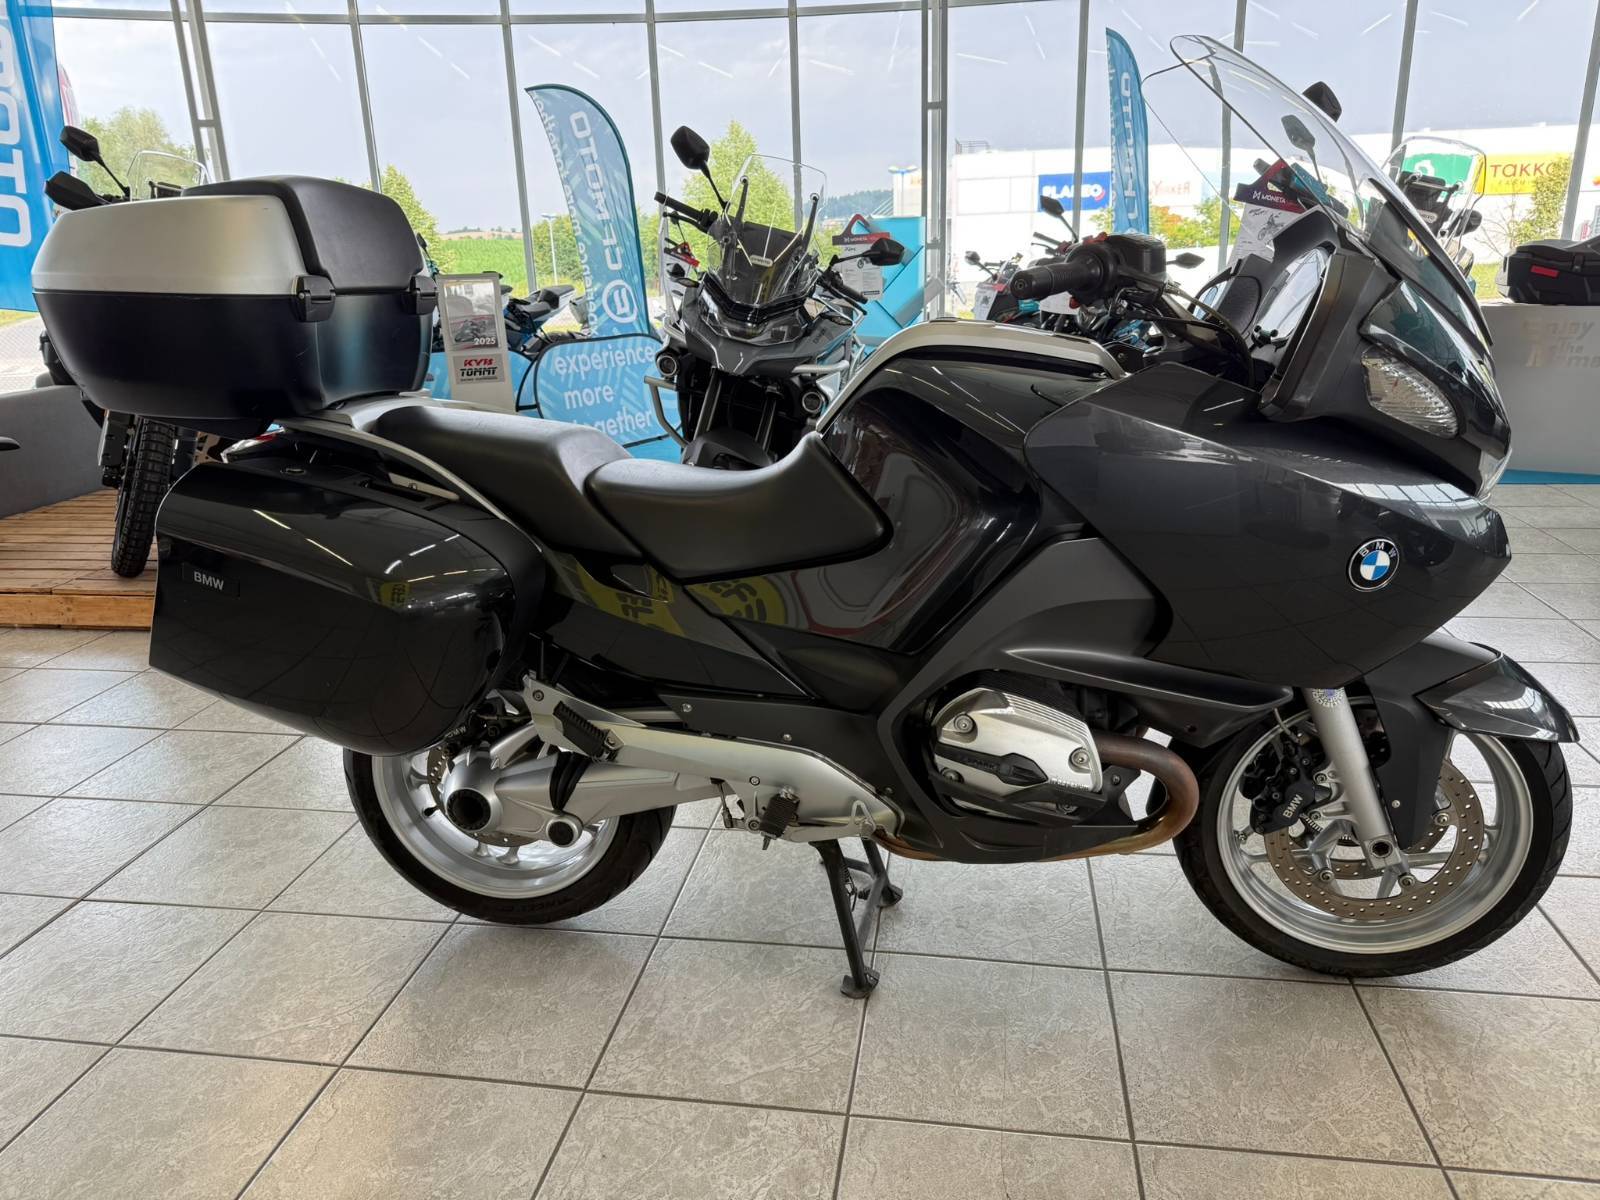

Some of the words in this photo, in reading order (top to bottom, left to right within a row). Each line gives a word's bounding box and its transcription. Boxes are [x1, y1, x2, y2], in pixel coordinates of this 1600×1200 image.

[1042, 184, 1103, 199] PLAEO
[1261, 194, 1286, 204] MONETA
[474, 337, 496, 345] 2025
[555, 344, 655, 380] experience
[564, 384, 614, 410] more
[574, 406, 653, 436] gether
[1359, 541, 1397, 558] BMW
[194, 571, 224, 590] BMW
[1282, 794, 1303, 818] BMW
